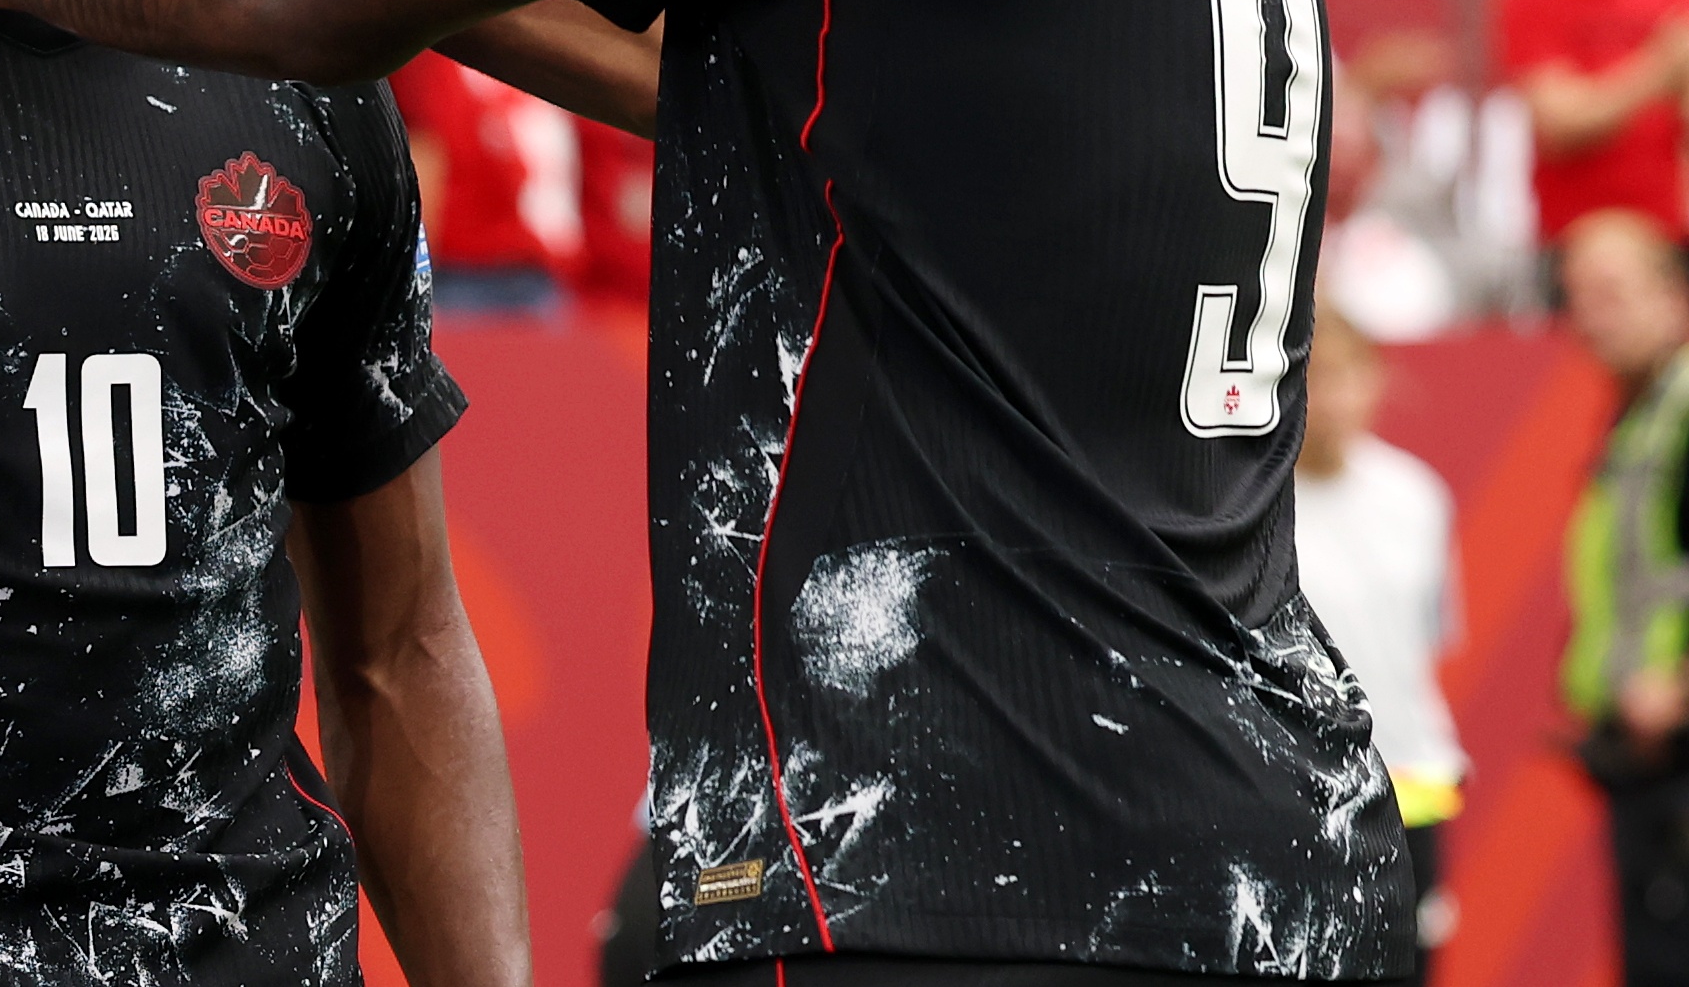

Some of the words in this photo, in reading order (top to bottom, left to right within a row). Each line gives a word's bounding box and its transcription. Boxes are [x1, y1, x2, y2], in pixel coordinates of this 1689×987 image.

[14, 202, 70, 218] CANADA
[85, 201, 133, 218] QATAR
[36, 225, 49, 241] 18
[53, 225, 85, 241] JUNE
[89, 225, 119, 241] 2026
[203, 209, 306, 240] CANADA
[23, 353, 167, 567] 10
